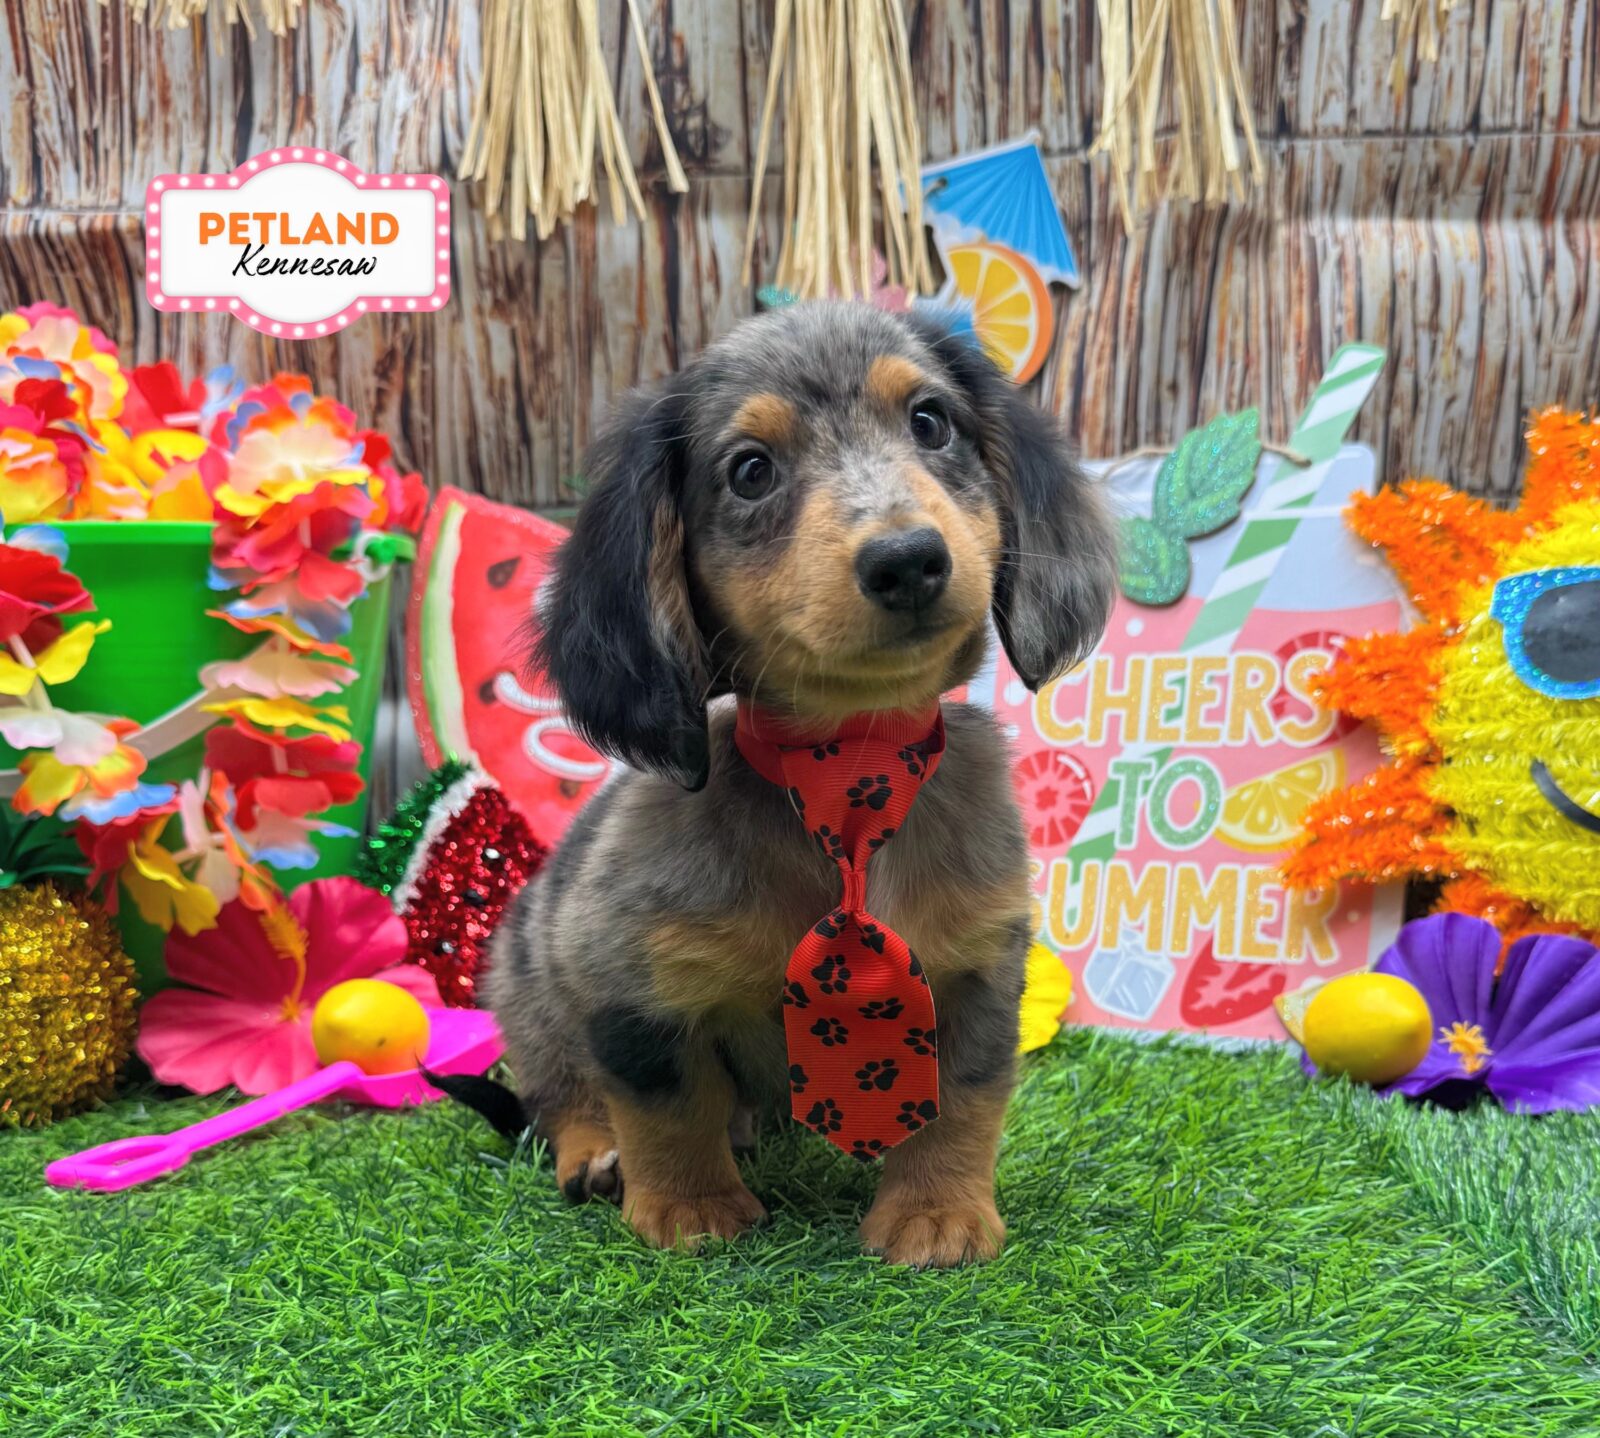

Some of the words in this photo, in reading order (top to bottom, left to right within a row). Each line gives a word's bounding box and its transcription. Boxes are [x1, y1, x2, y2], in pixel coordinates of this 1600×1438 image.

[1034, 652, 1338, 744] CHEERS
[1111, 758, 1222, 848] TO
[1029, 860, 1339, 964] UMMER
